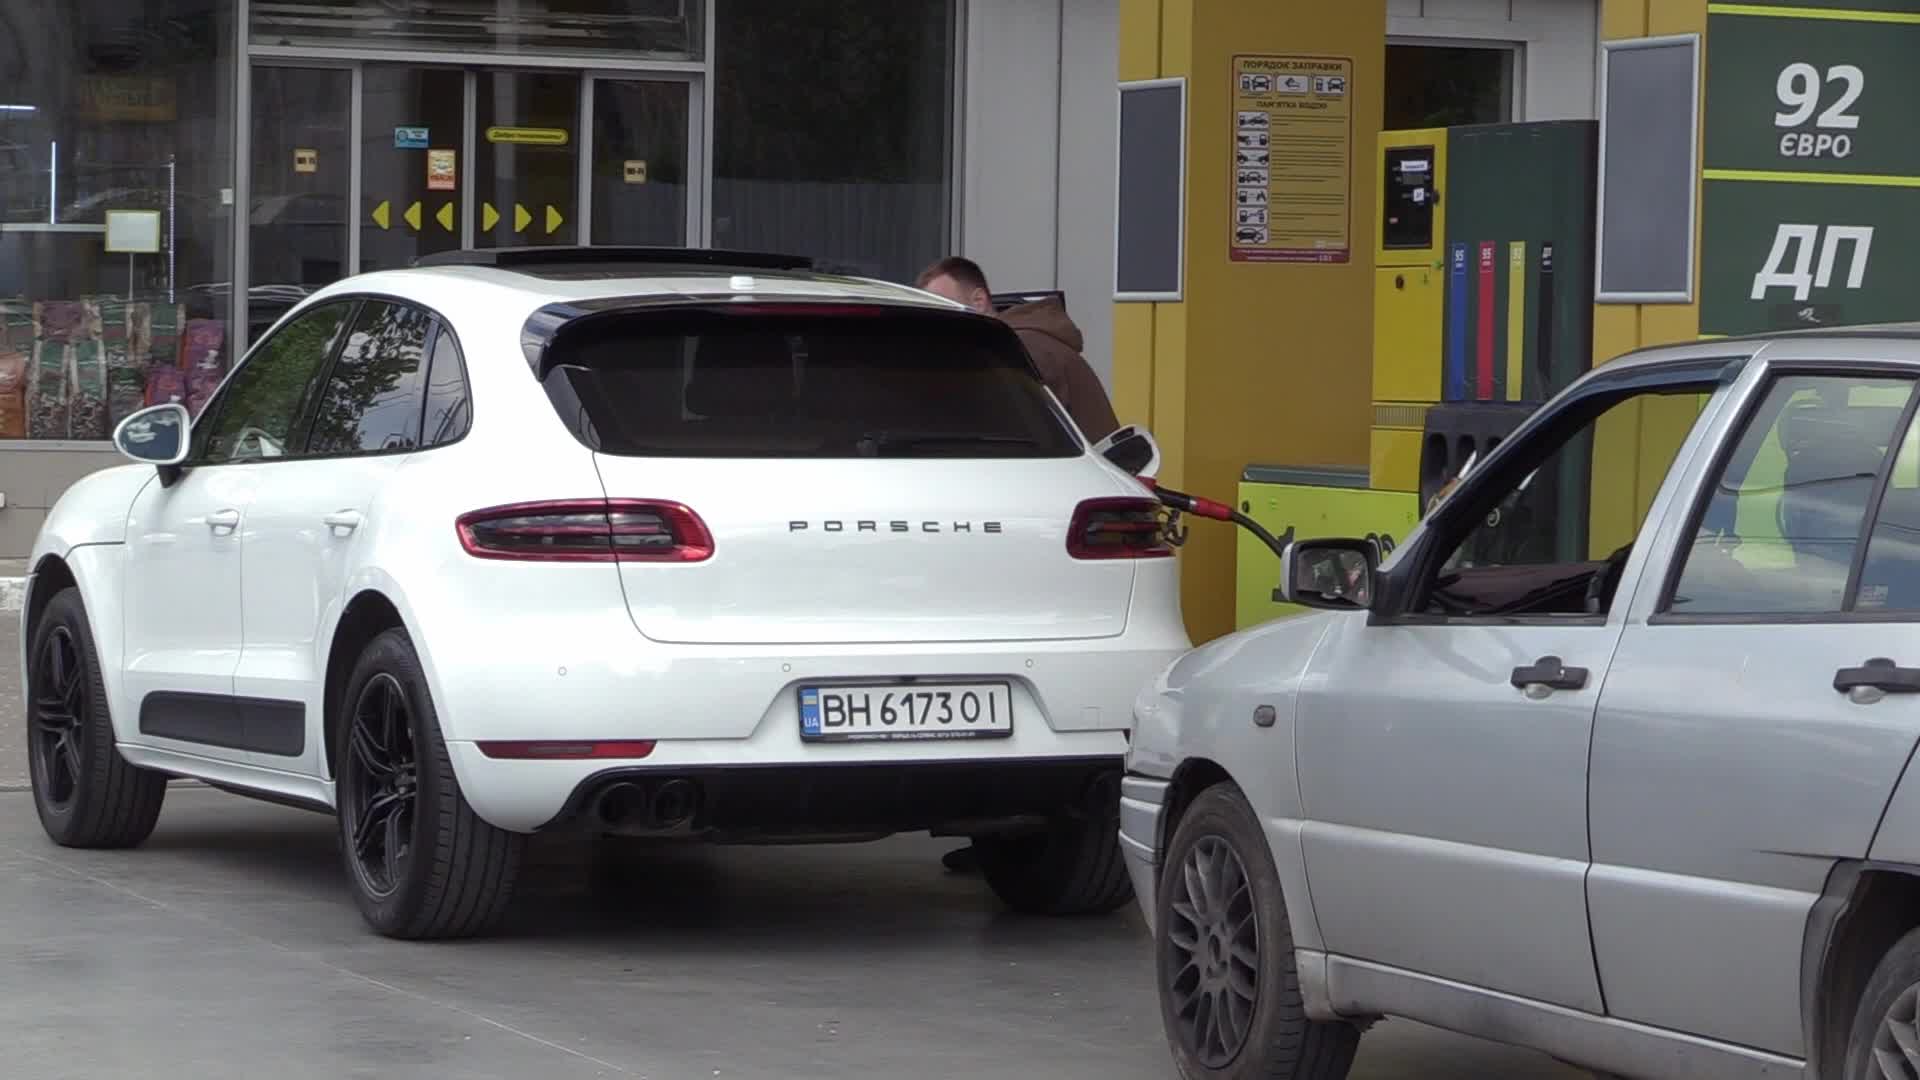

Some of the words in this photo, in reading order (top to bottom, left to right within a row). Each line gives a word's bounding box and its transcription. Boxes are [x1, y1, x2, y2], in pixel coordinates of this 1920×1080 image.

[1243, 61, 1289, 69] ПОРЯДОК
[1292, 62, 1342, 70] ЗАПРАВКИ
[1774, 62, 1864, 129] 92
[1780, 133, 1851, 158] ЄВРО
[1750, 223, 1875, 301] ДП
[789, 520, 1002, 533] PORSCHE
[804, 716, 819, 728] UA
[823, 694, 871, 727] BH
[880, 692, 953, 726] 6173
